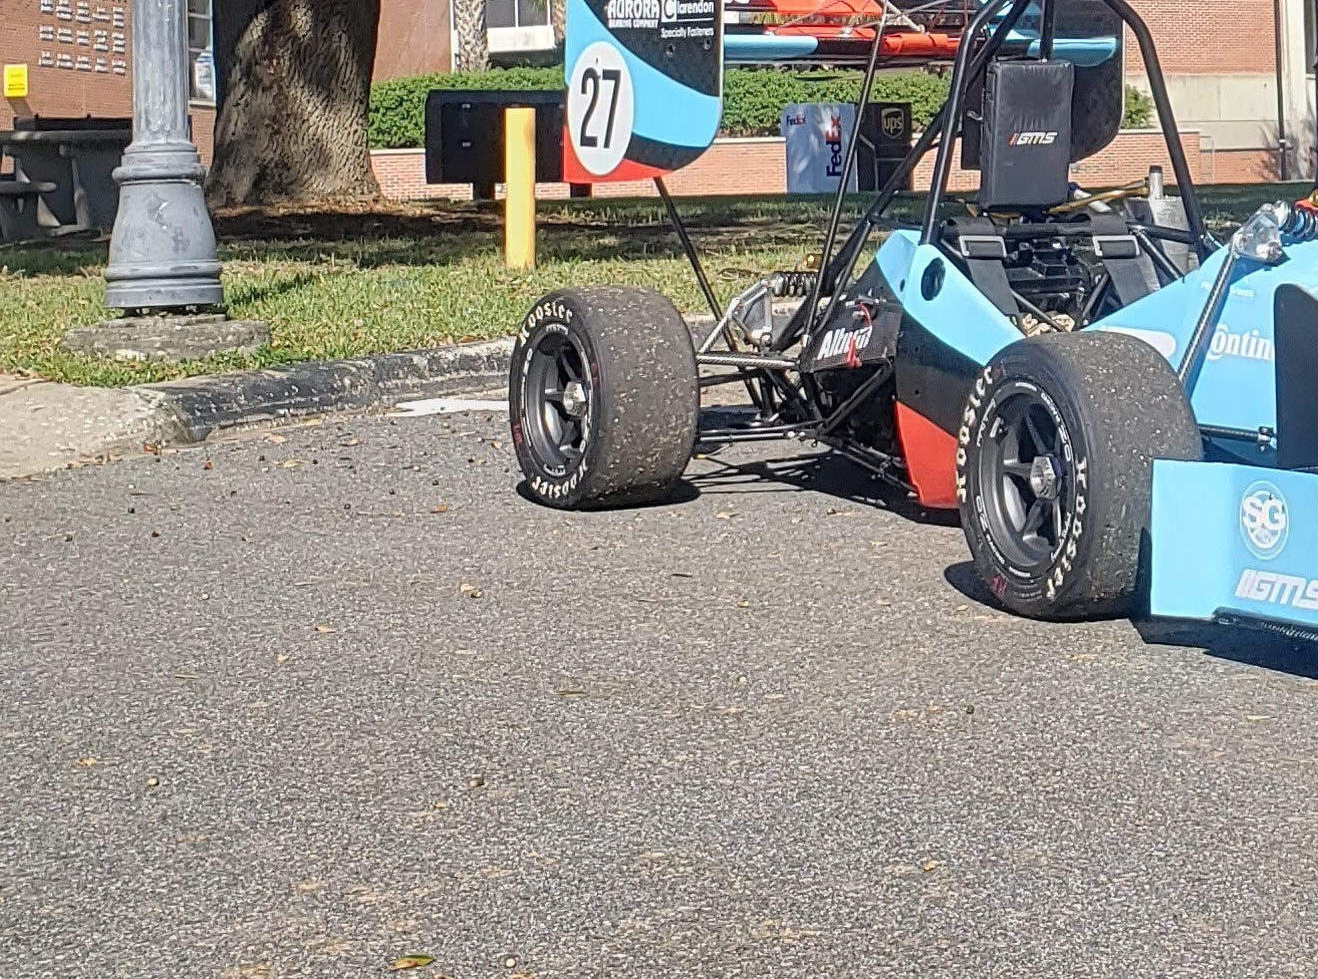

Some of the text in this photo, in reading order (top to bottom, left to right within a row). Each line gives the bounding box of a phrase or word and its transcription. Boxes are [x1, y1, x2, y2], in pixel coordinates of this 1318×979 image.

[580, 66, 622, 149] 27
[883, 116, 904, 134] ups
[826, 115, 842, 177] FedEx
[519, 301, 574, 347] Hoosier
[1206, 322, 1275, 361] Contin
[1242, 495, 1286, 531] SG
